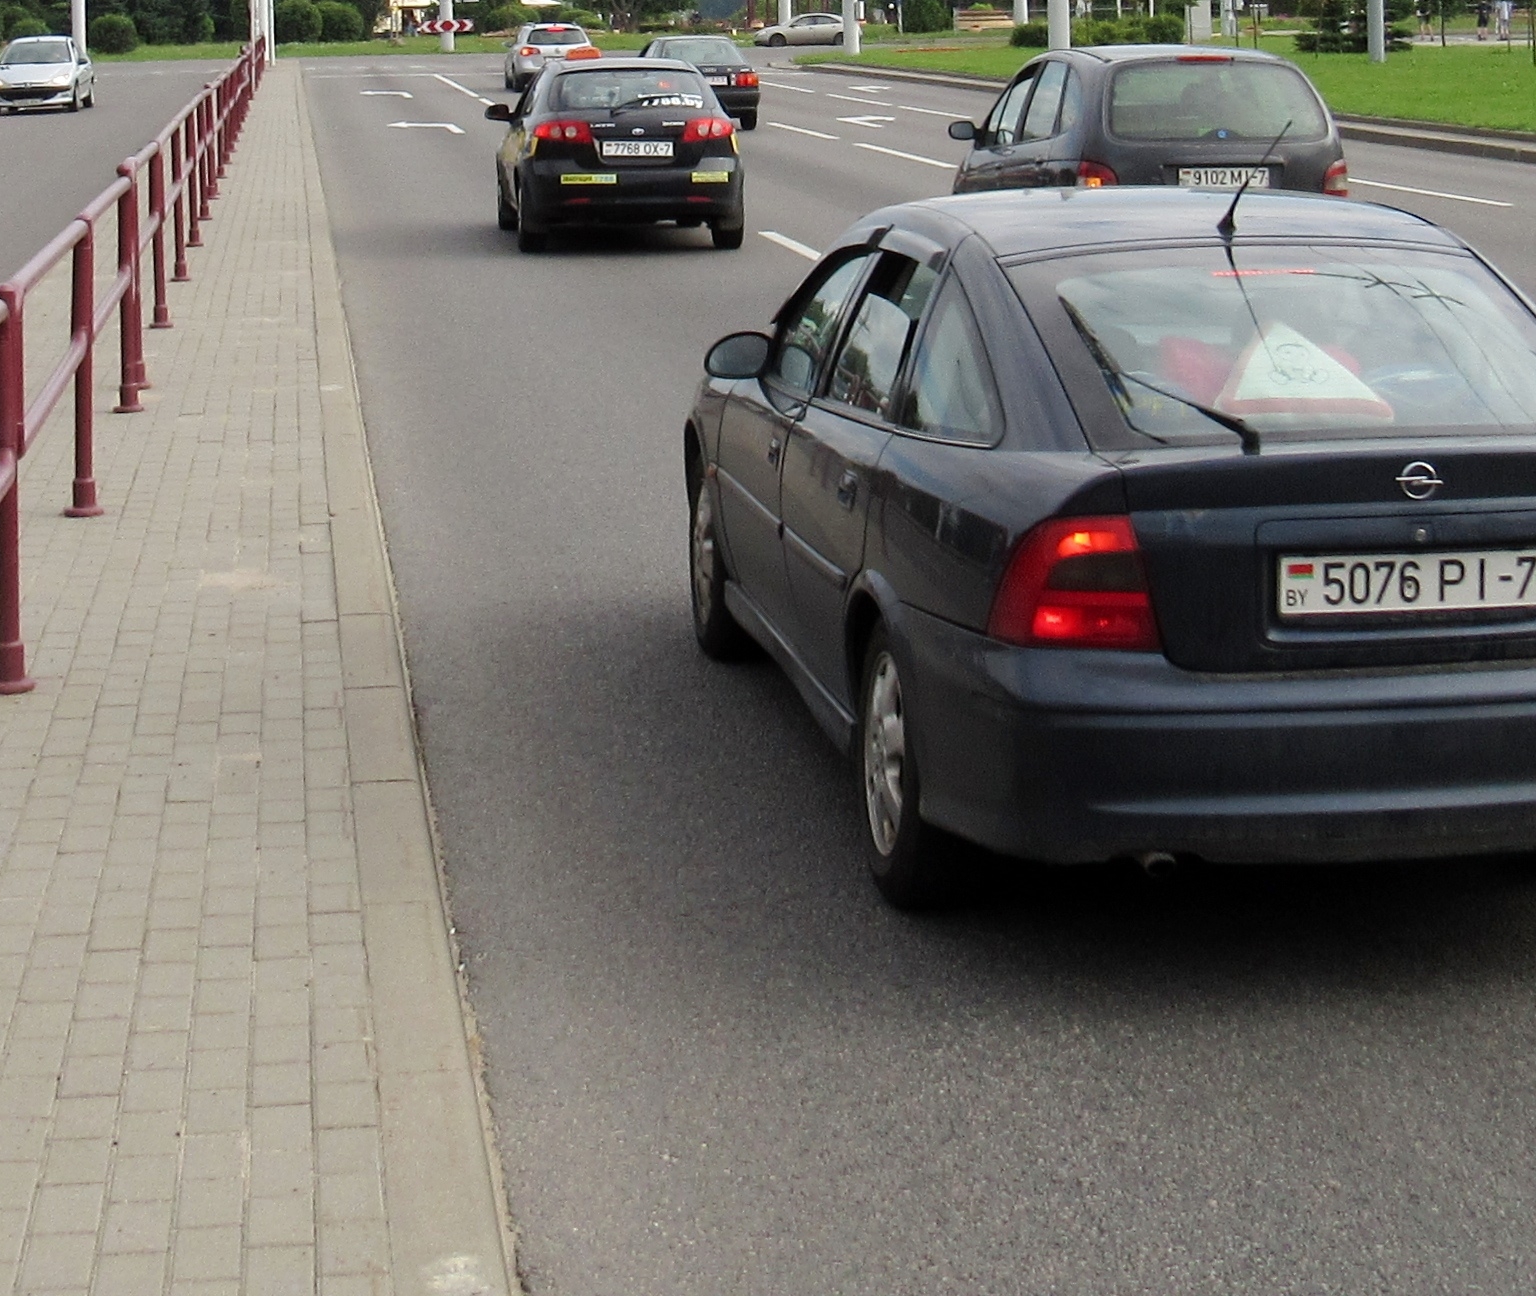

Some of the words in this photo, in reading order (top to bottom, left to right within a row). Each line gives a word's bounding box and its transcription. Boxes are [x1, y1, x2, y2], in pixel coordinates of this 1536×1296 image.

[614, 143, 640, 155] 7768
[644, 143, 671, 155] OX-7
[1193, 170, 1227, 185] 9102
[1323, 561, 1420, 605] 5076
[1285, 589, 1308, 606] BY
